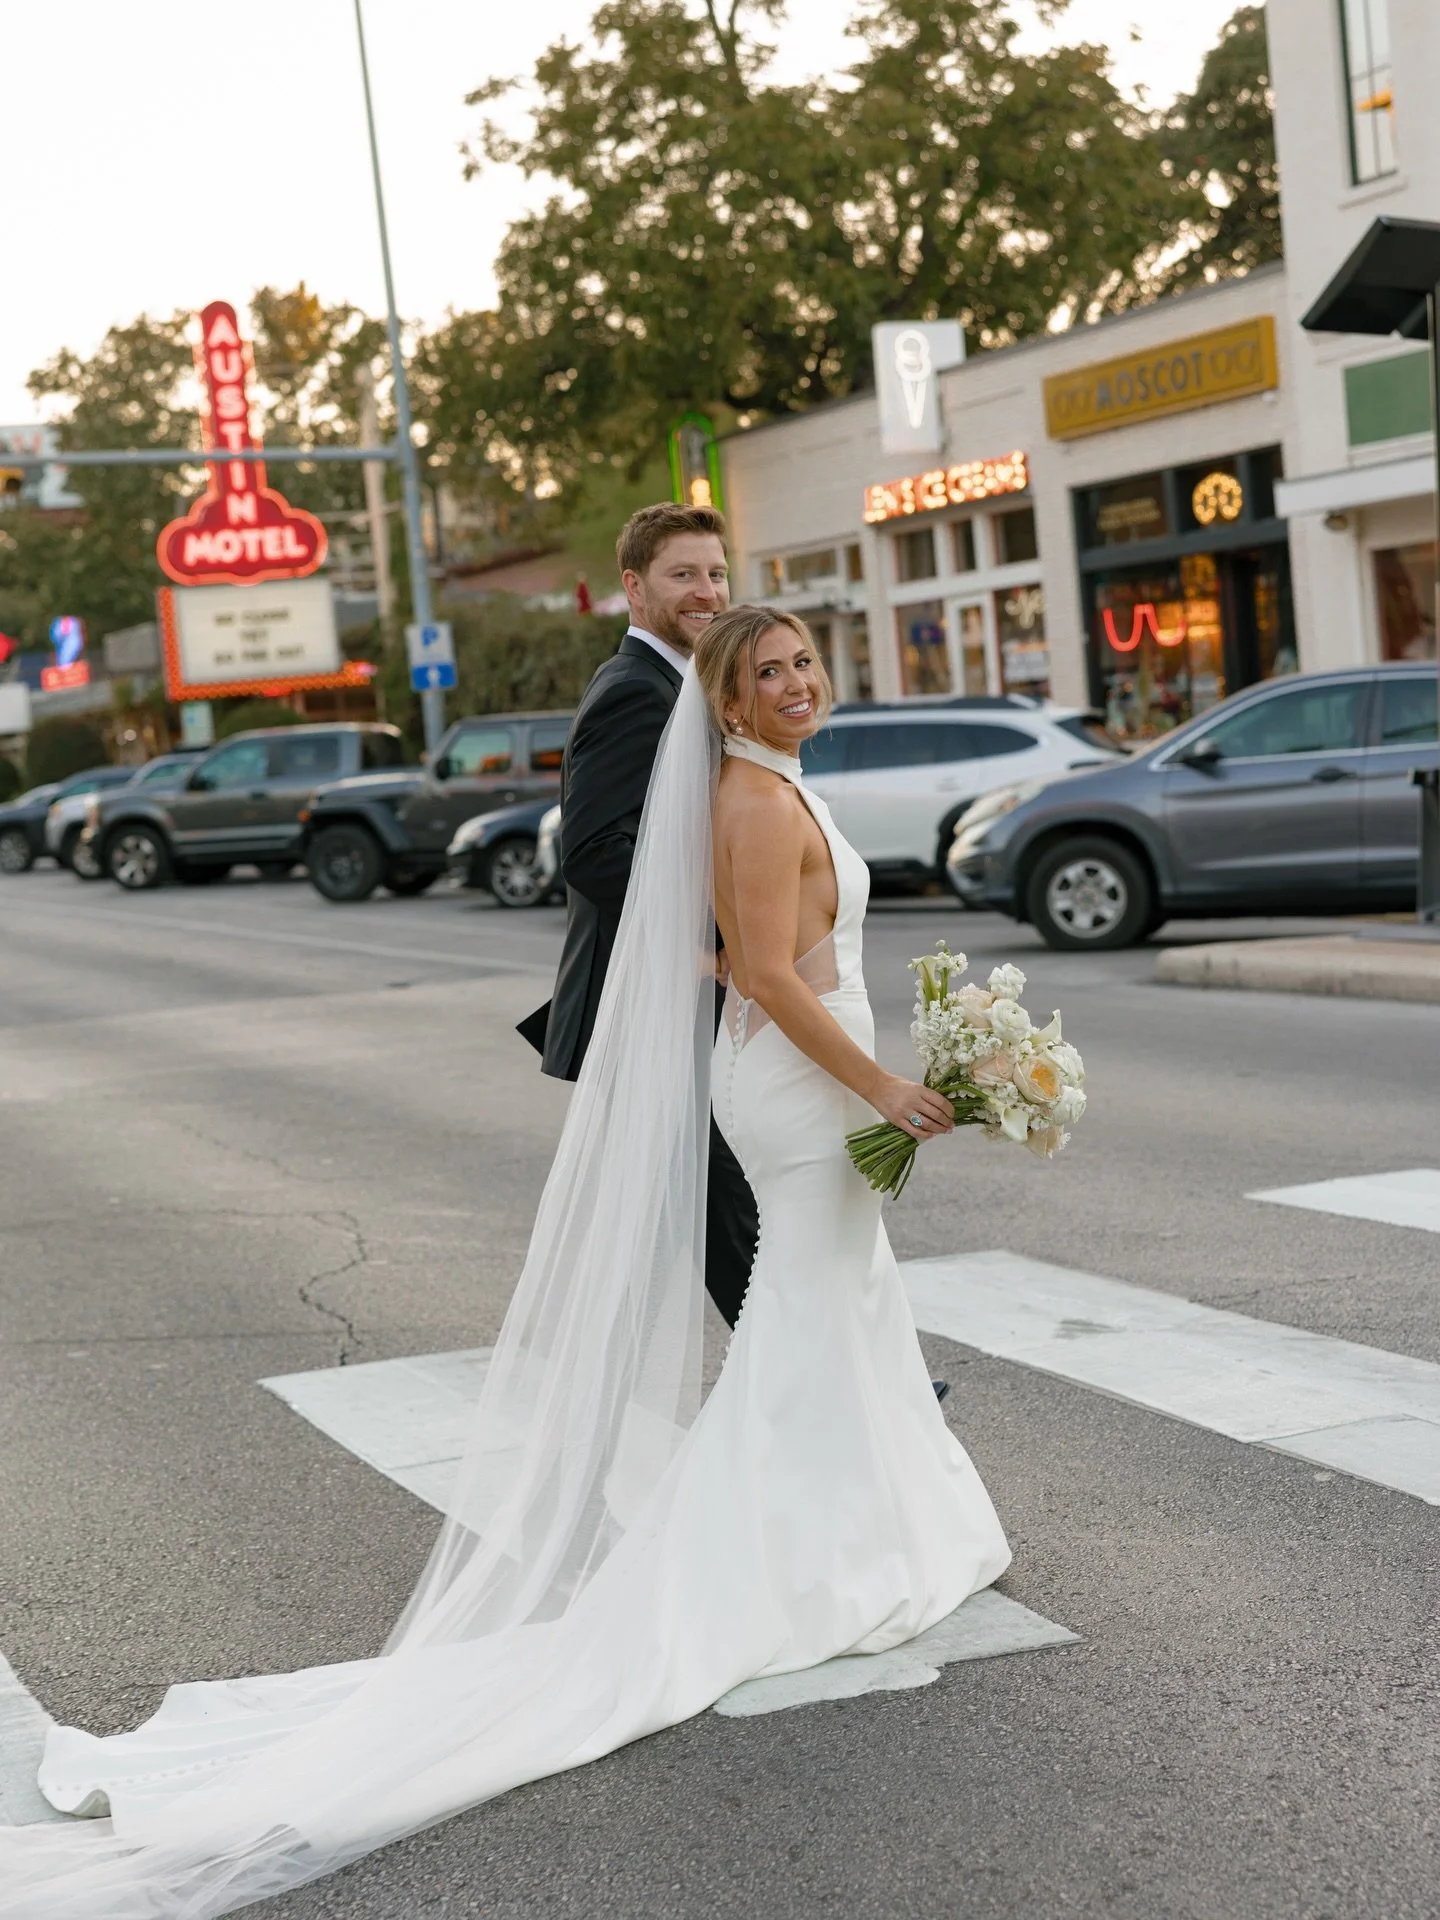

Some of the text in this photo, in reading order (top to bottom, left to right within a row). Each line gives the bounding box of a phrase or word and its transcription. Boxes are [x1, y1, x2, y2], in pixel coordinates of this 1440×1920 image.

[1096, 350, 1204, 412] MOSCOT
[207, 314, 257, 525] AUSTIN
[183, 526, 308, 566] MOTEL
[421, 625, 438, 647] P
